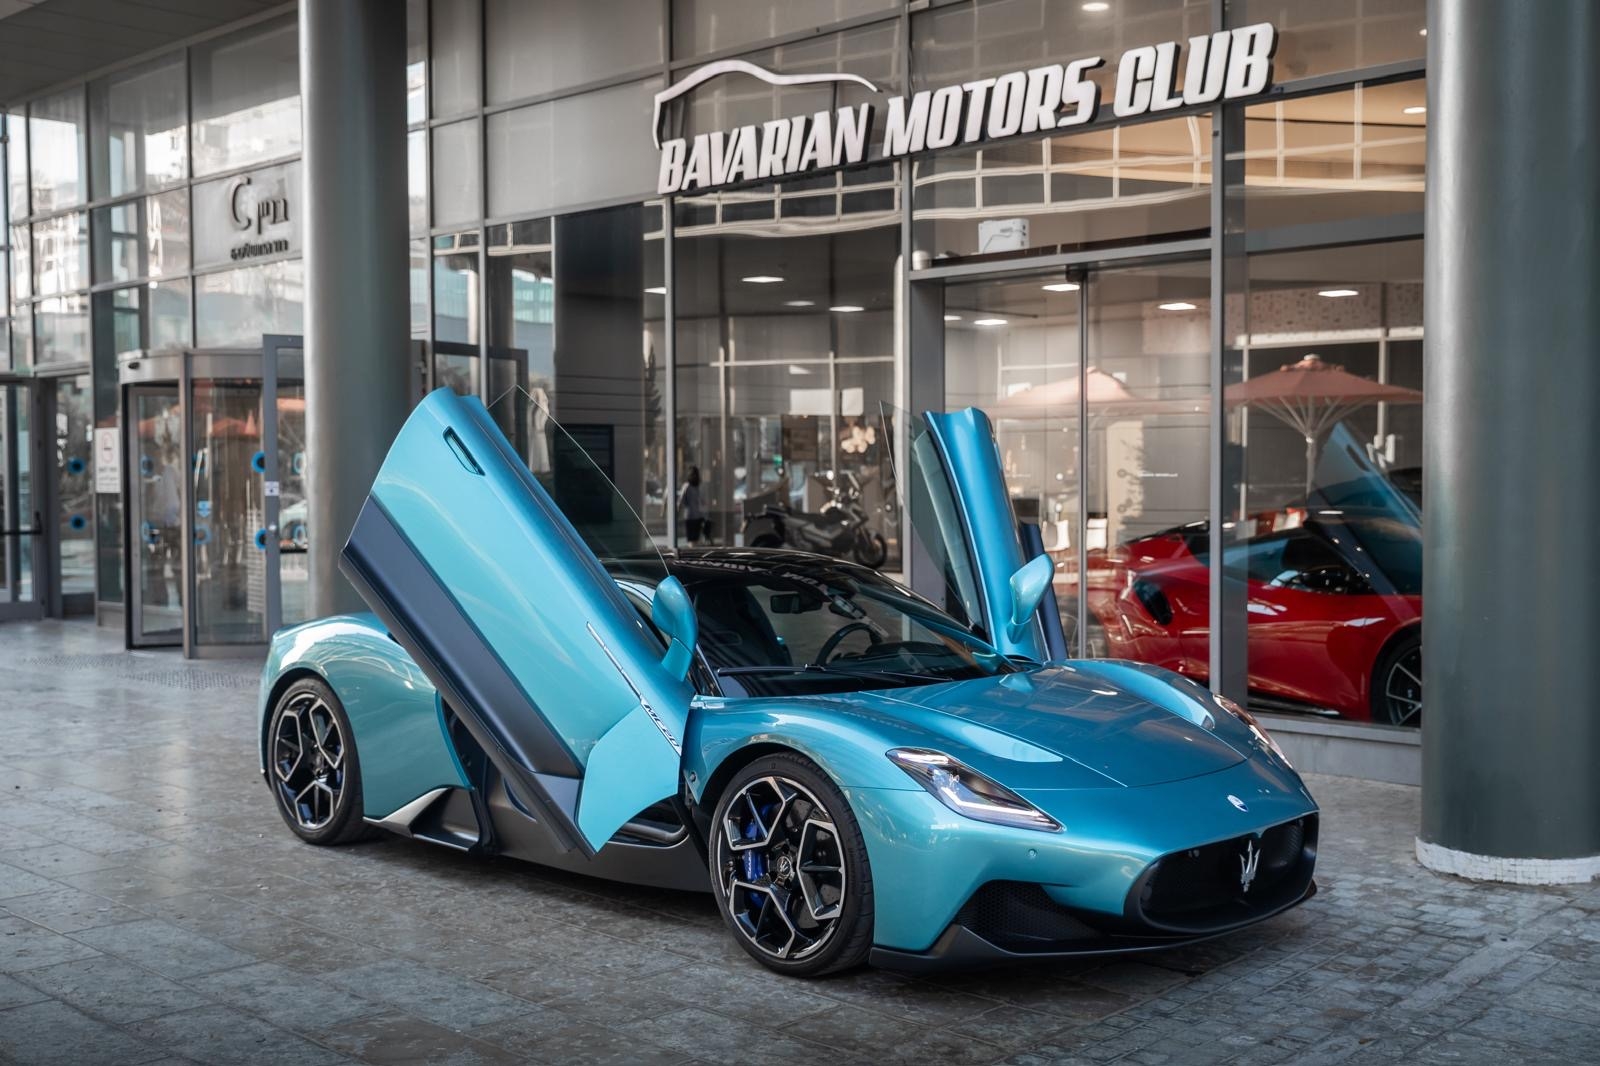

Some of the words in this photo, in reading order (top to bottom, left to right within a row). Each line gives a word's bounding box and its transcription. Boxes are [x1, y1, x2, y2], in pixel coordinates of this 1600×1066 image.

[656, 102, 872, 195] BAVARIAN
[882, 57, 1104, 157] MOTORS
[1113, 22, 1277, 119] CLUB
